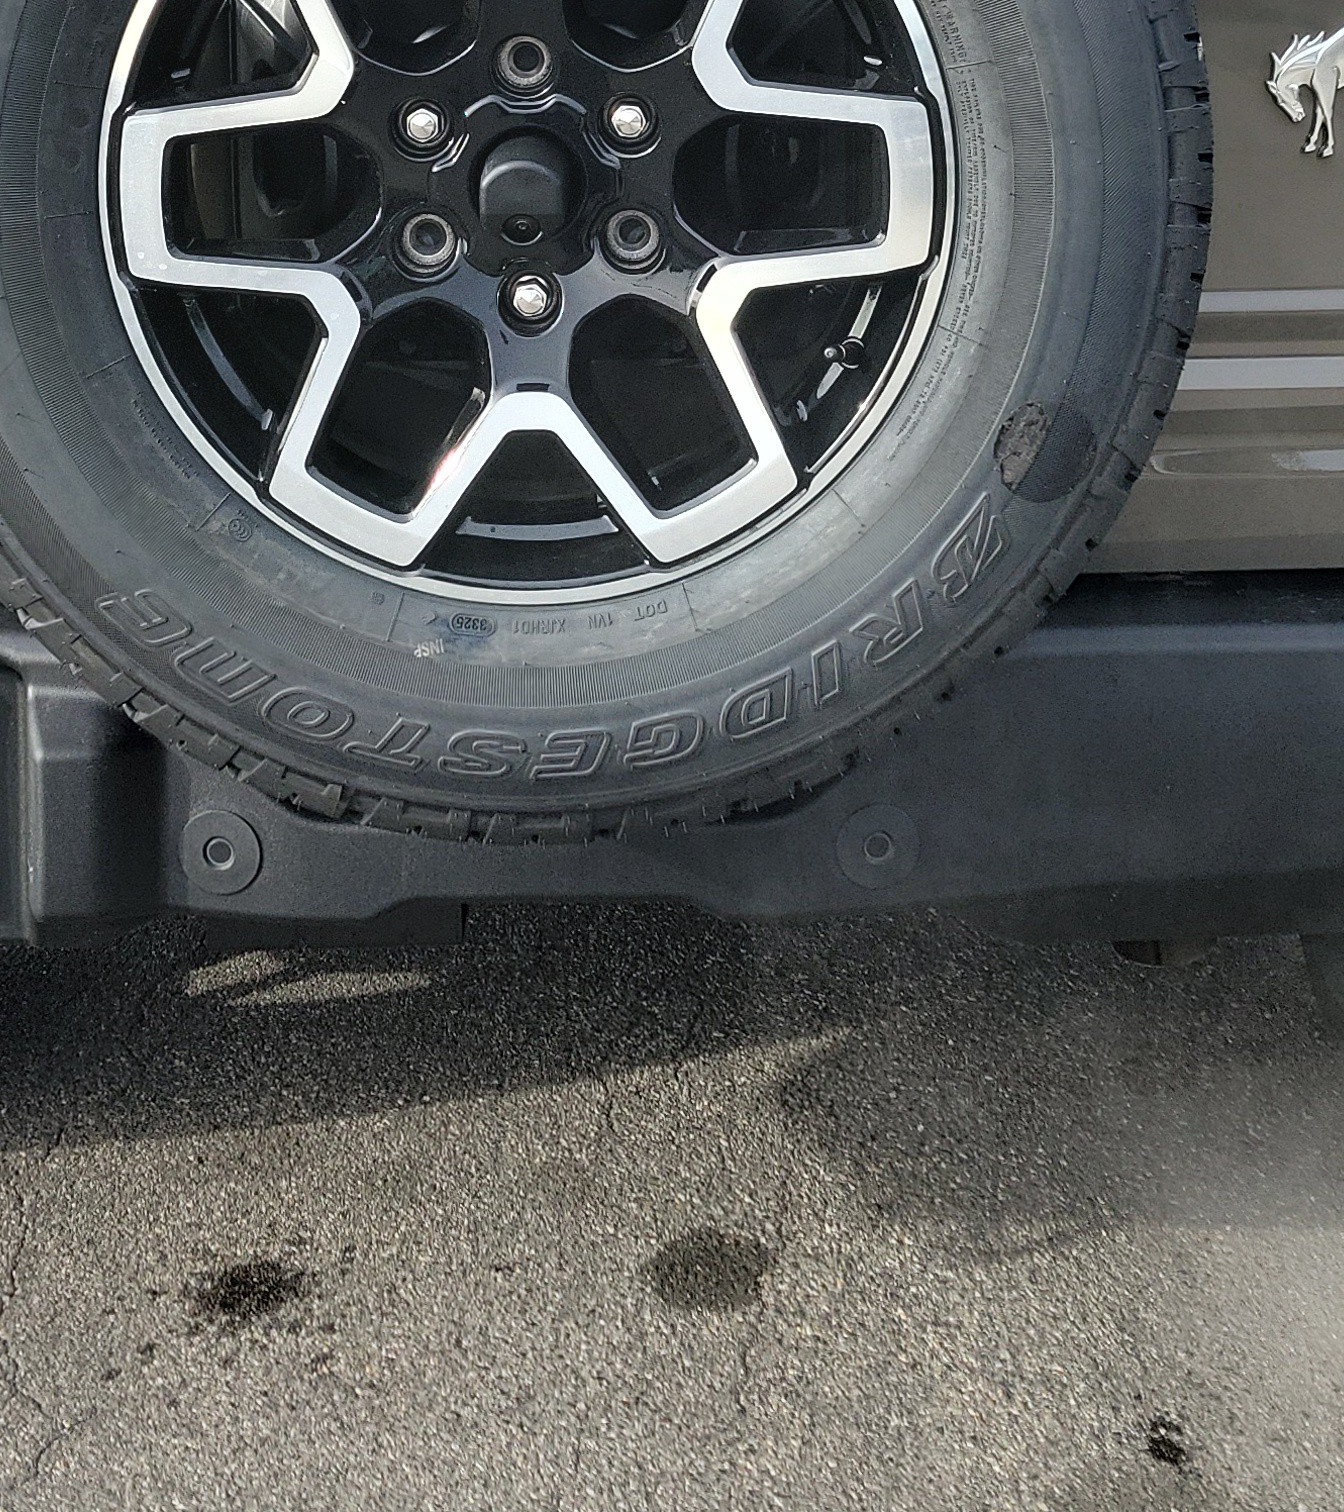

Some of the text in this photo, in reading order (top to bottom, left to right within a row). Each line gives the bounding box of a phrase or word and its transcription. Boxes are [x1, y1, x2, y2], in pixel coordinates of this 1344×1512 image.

[635, 600, 668, 621] DOT
[456, 616, 487, 632] 3325
[413, 638, 445, 658] INSP
